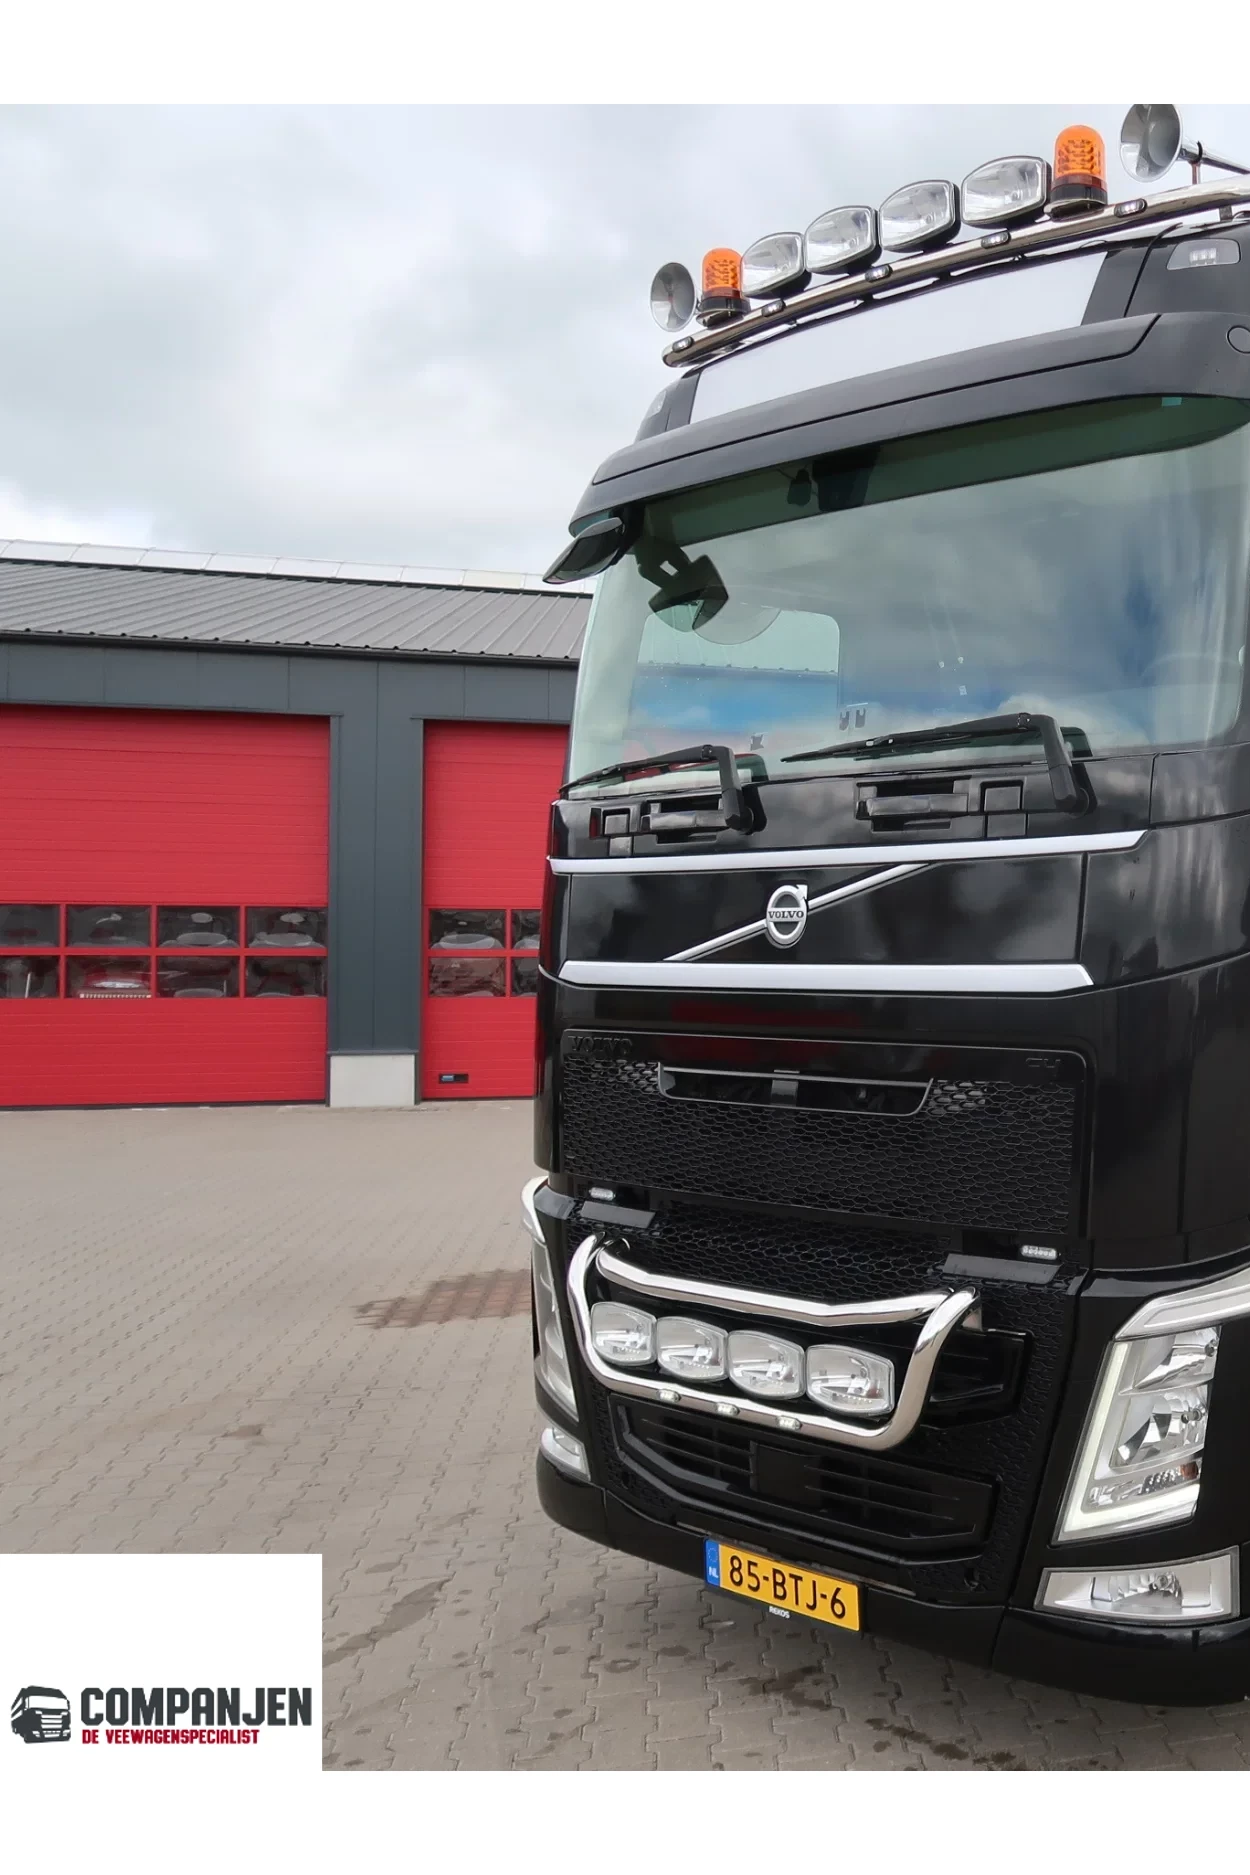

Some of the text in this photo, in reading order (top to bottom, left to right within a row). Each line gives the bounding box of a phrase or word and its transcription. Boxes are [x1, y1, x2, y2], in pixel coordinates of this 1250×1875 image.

[768, 910, 805, 919] VOLVO
[567, 1035, 633, 1055] VOLVO
[708, 1566, 719, 1579] NL
[729, 1555, 846, 1619] 85-BTJ-6
